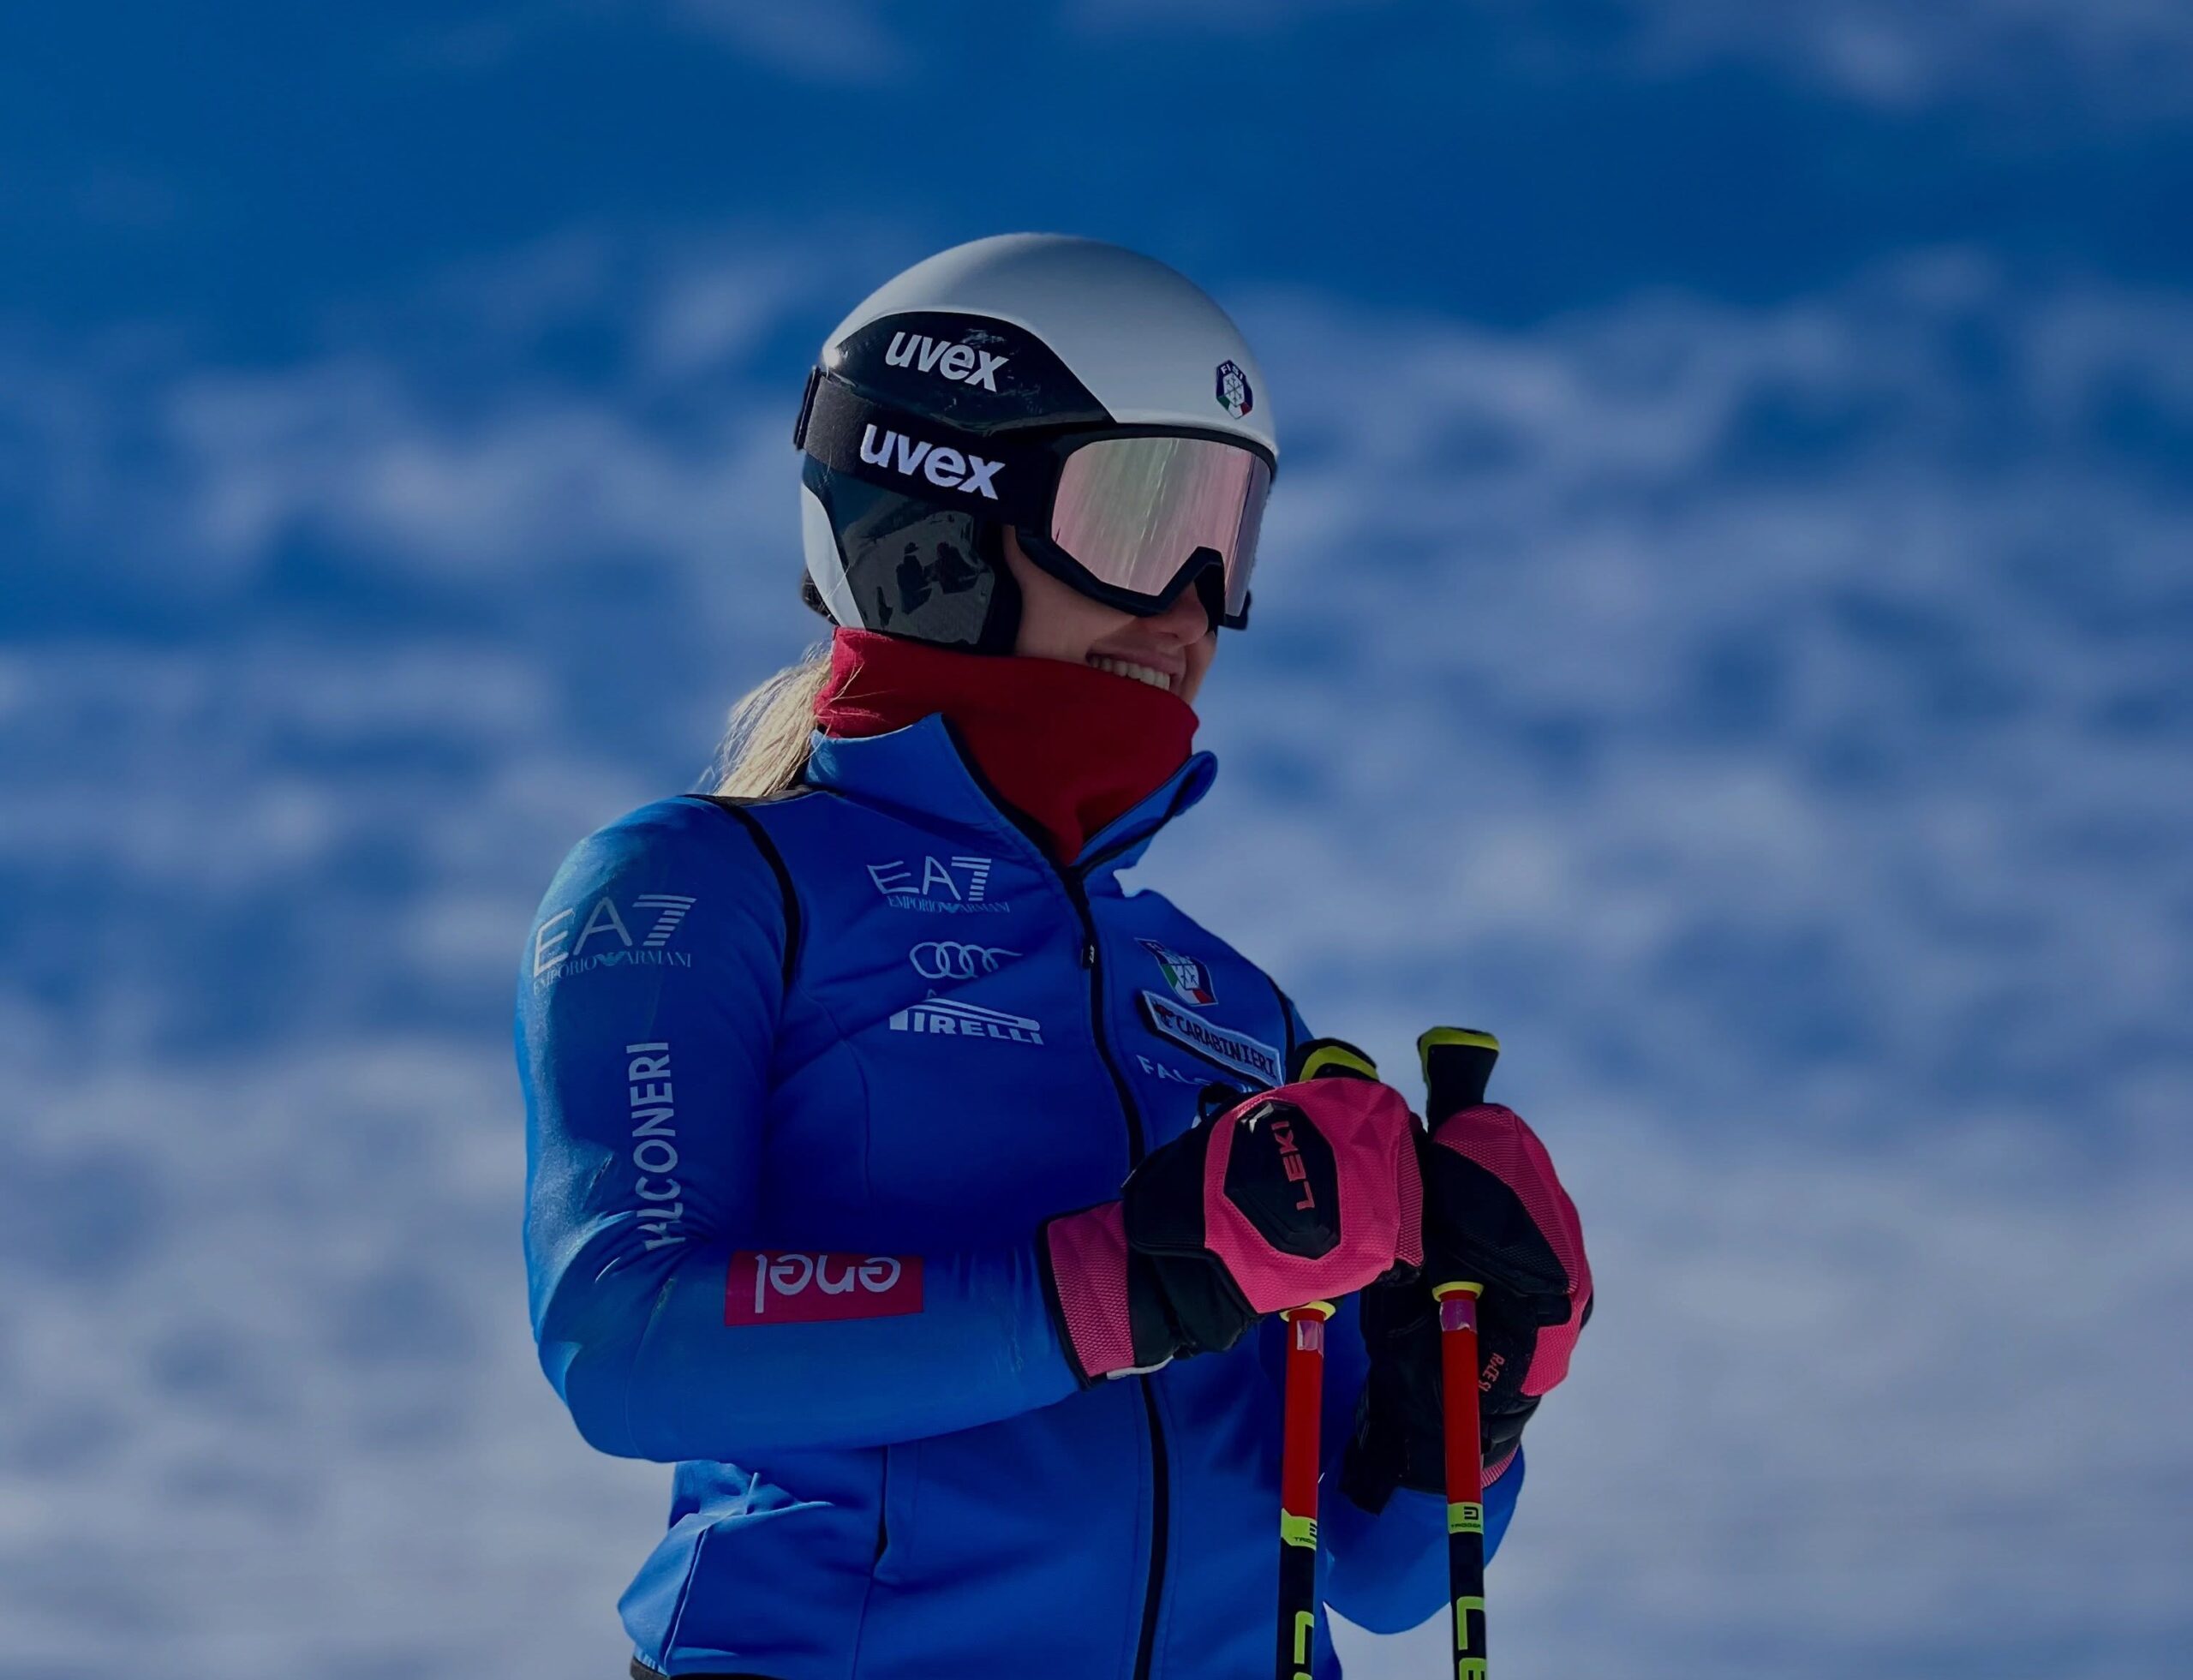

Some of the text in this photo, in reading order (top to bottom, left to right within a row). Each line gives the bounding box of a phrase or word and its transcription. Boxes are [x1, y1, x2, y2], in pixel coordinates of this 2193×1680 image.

[885, 332, 1009, 392] uvex
[859, 423, 1006, 500] uvex
[867, 856, 992, 901] EA7
[534, 894, 697, 978] EA7
[623, 949, 691, 968] ARMANI
[889, 997, 1044, 1045] PIRELLI
[1176, 1013, 1278, 1080] CARABINIERI
[1271, 1121, 1315, 1211] LEKI
[755, 1254, 901, 1314] enel
